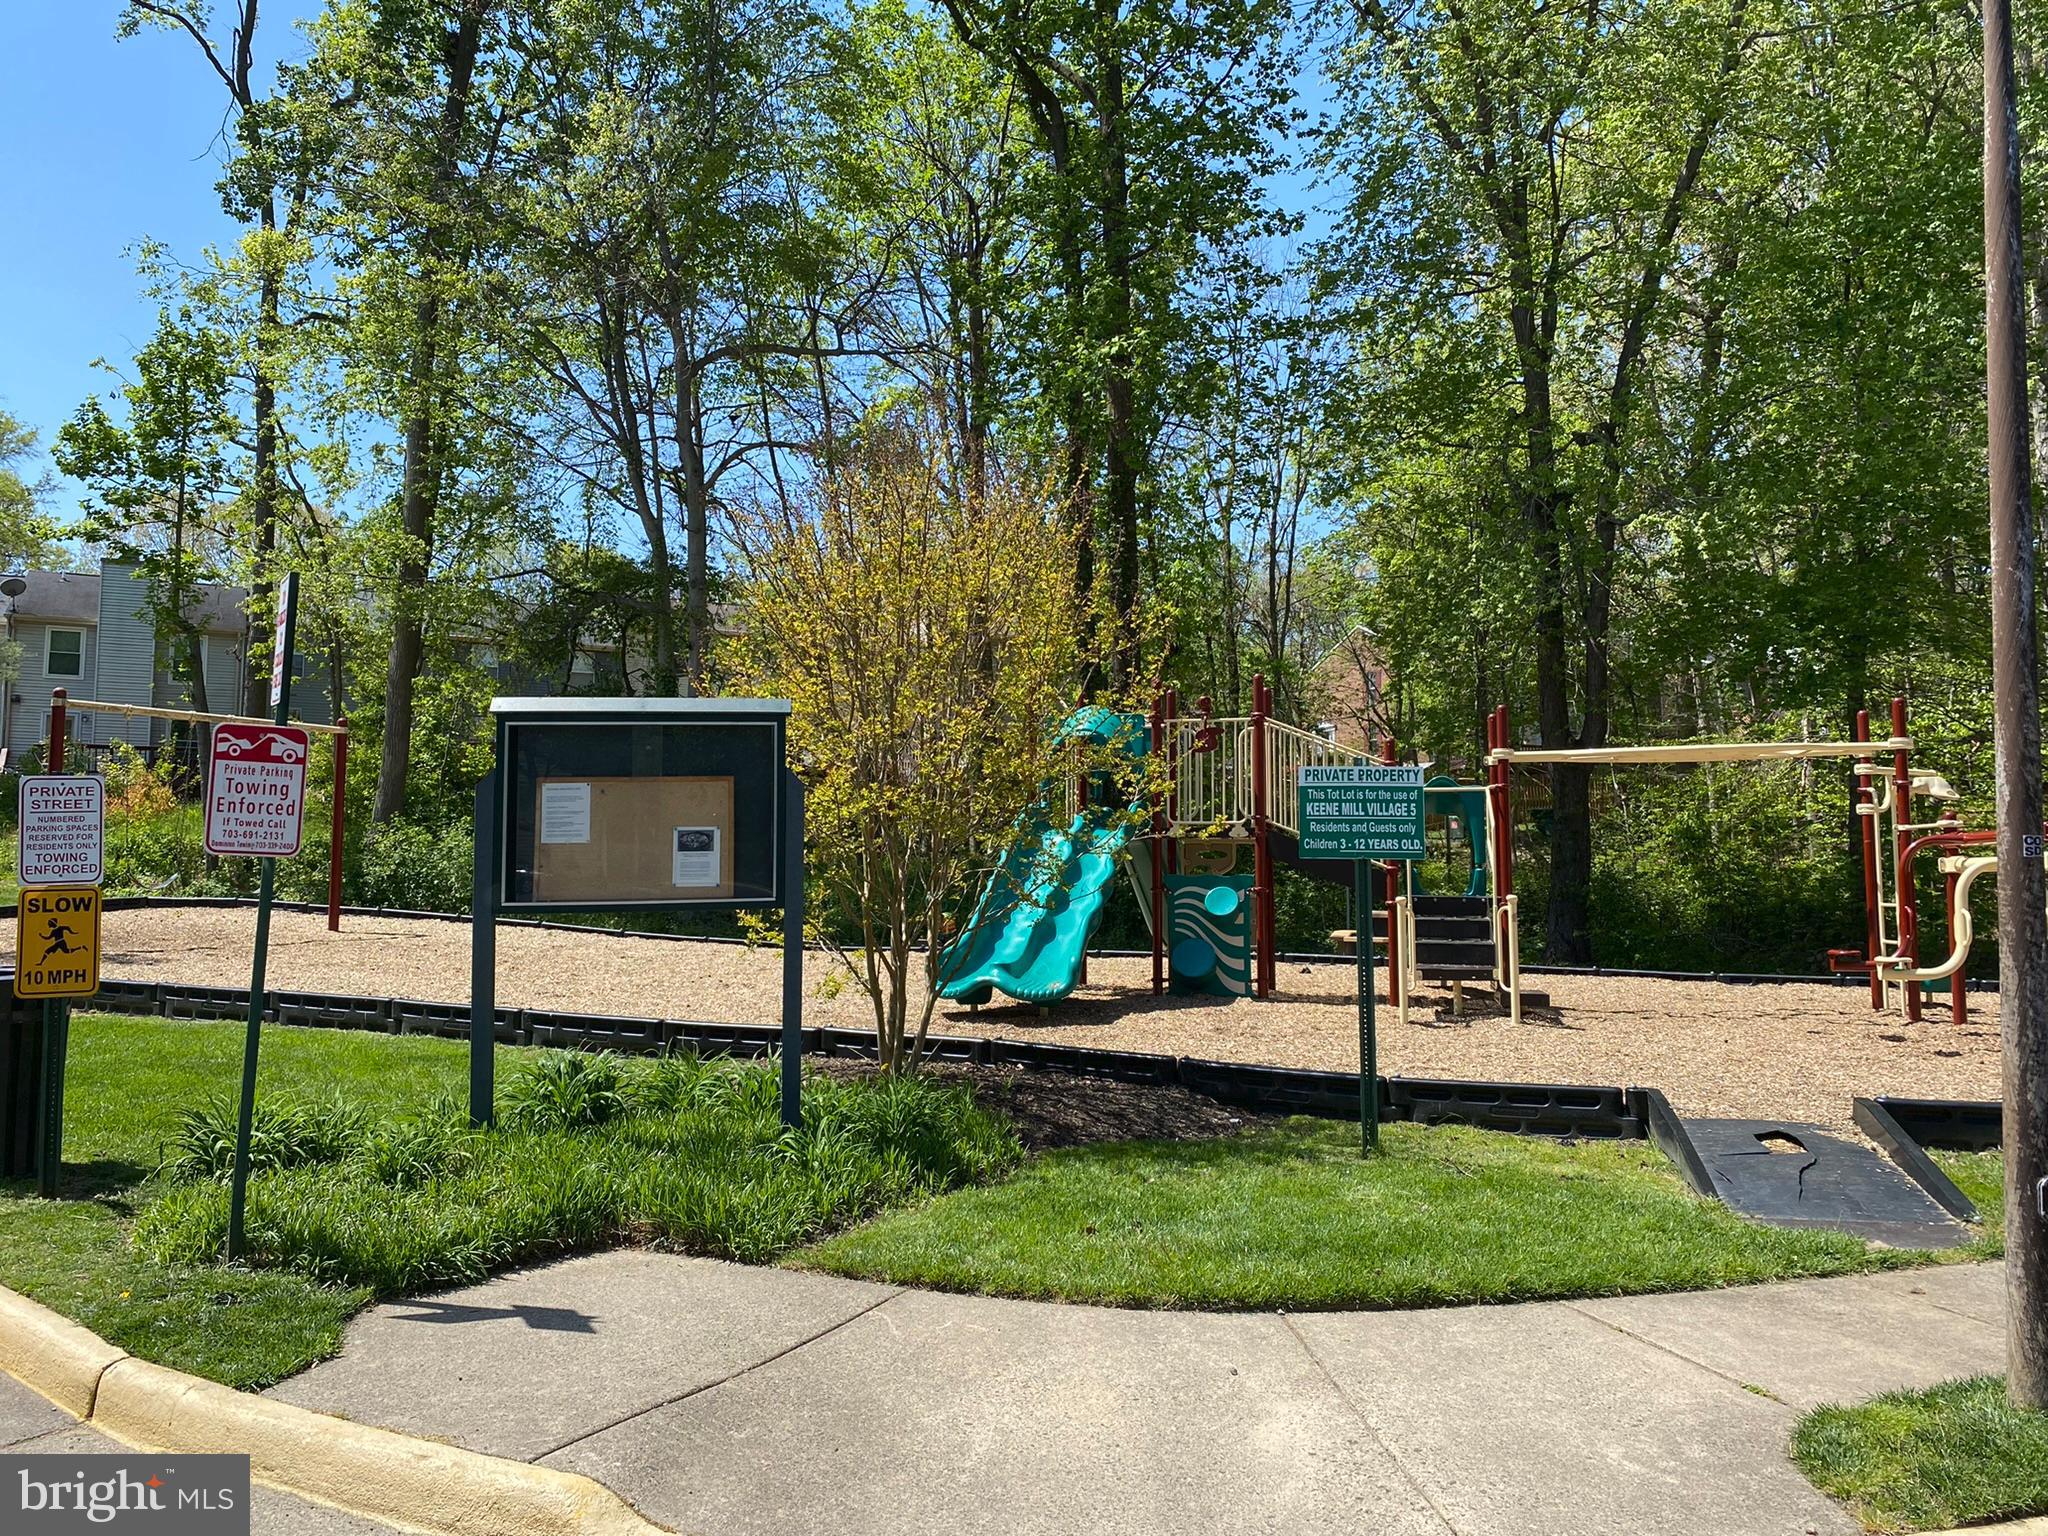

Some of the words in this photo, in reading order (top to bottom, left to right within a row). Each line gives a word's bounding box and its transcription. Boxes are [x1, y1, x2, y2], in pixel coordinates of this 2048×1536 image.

[224, 763, 256, 776] Private
[260, 766, 294, 780] Parking
[1304, 768, 1354, 781] PRIVATE
[1358, 769, 1420, 781] PROPERTY
[30, 786, 95, 797] PRIVATE
[226, 777, 289, 800] Towing
[1307, 789, 1325, 800] This
[1326, 789, 1340, 800] Tot
[1341, 789, 1355, 800] Lot
[1356, 789, 1363, 800] is
[1365, 789, 1377, 800] for
[1378, 789, 1391, 800] the
[1393, 790, 1407, 800] use
[1409, 789, 1418, 800] of
[31, 799, 94, 810] STREET
[216, 797, 296, 816] Enforced
[1306, 802, 1339, 816] KEENE
[1341, 802, 1365, 816] MILL
[1366, 802, 1408, 816] VILLAGE
[1410, 803, 1417, 816] 5
[37, 815, 86, 823] NUMBERED
[222, 817, 231, 826] If
[234, 818, 264, 828] Towed
[267, 819, 287, 829] Call
[25, 825, 64, 833] PARKING
[66, 824, 99, 832] SPACES
[1310, 821, 1350, 833] Residents
[1352, 822, 1367, 833] and
[1369, 822, 1397, 833] Guests
[1399, 822, 1416, 835] only
[222, 830, 284, 840] 703-691-2131
[2024, 836, 2041, 845] CO
[1304, 838, 1338, 850] Children
[1340, 839, 1346, 849] 3
[1354, 839, 1366, 850] 12
[1367, 839, 1399, 850] YEARS
[1401, 840, 1423, 850] OLD.
[2025, 846, 2041, 856] SD
[35, 852, 88, 863] TOWING
[25, 864, 98, 875] ENFORCED
[27, 896, 93, 913] SLOW
[24, 970, 43, 985] 10
[47, 969, 86, 984] MPH
